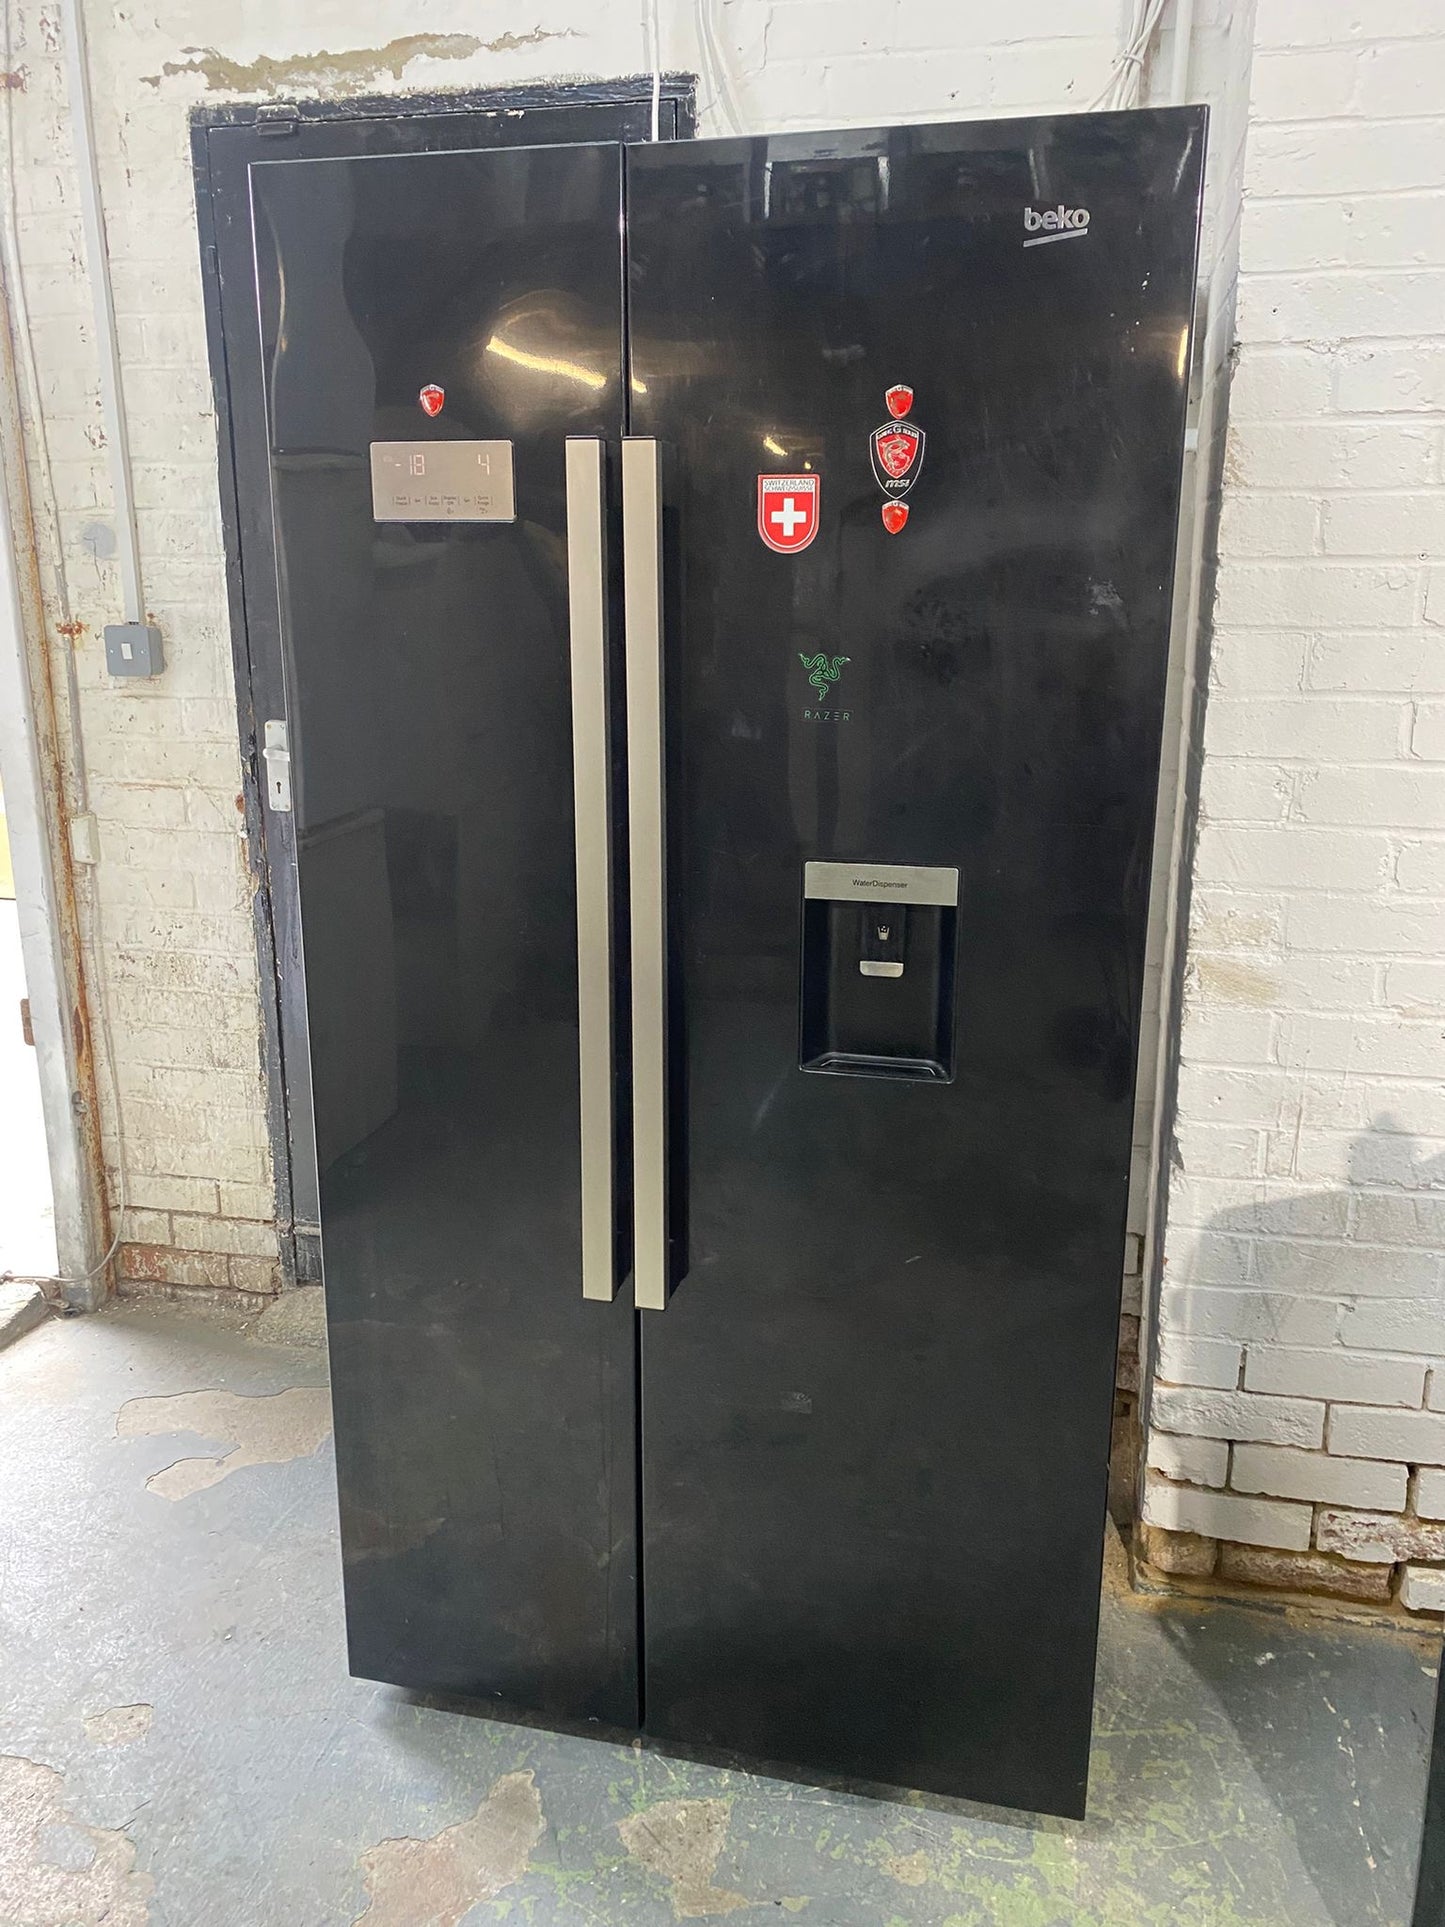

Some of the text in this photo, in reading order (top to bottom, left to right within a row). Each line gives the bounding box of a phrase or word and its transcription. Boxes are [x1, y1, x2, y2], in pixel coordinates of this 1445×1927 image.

[1024, 205, 1090, 231] beko
[478, 454, 490, 475] 4
[885, 479, 911, 488] msi
[804, 709, 850, 721] RAZER
[852, 879, 908, 889] WaterDispenser
